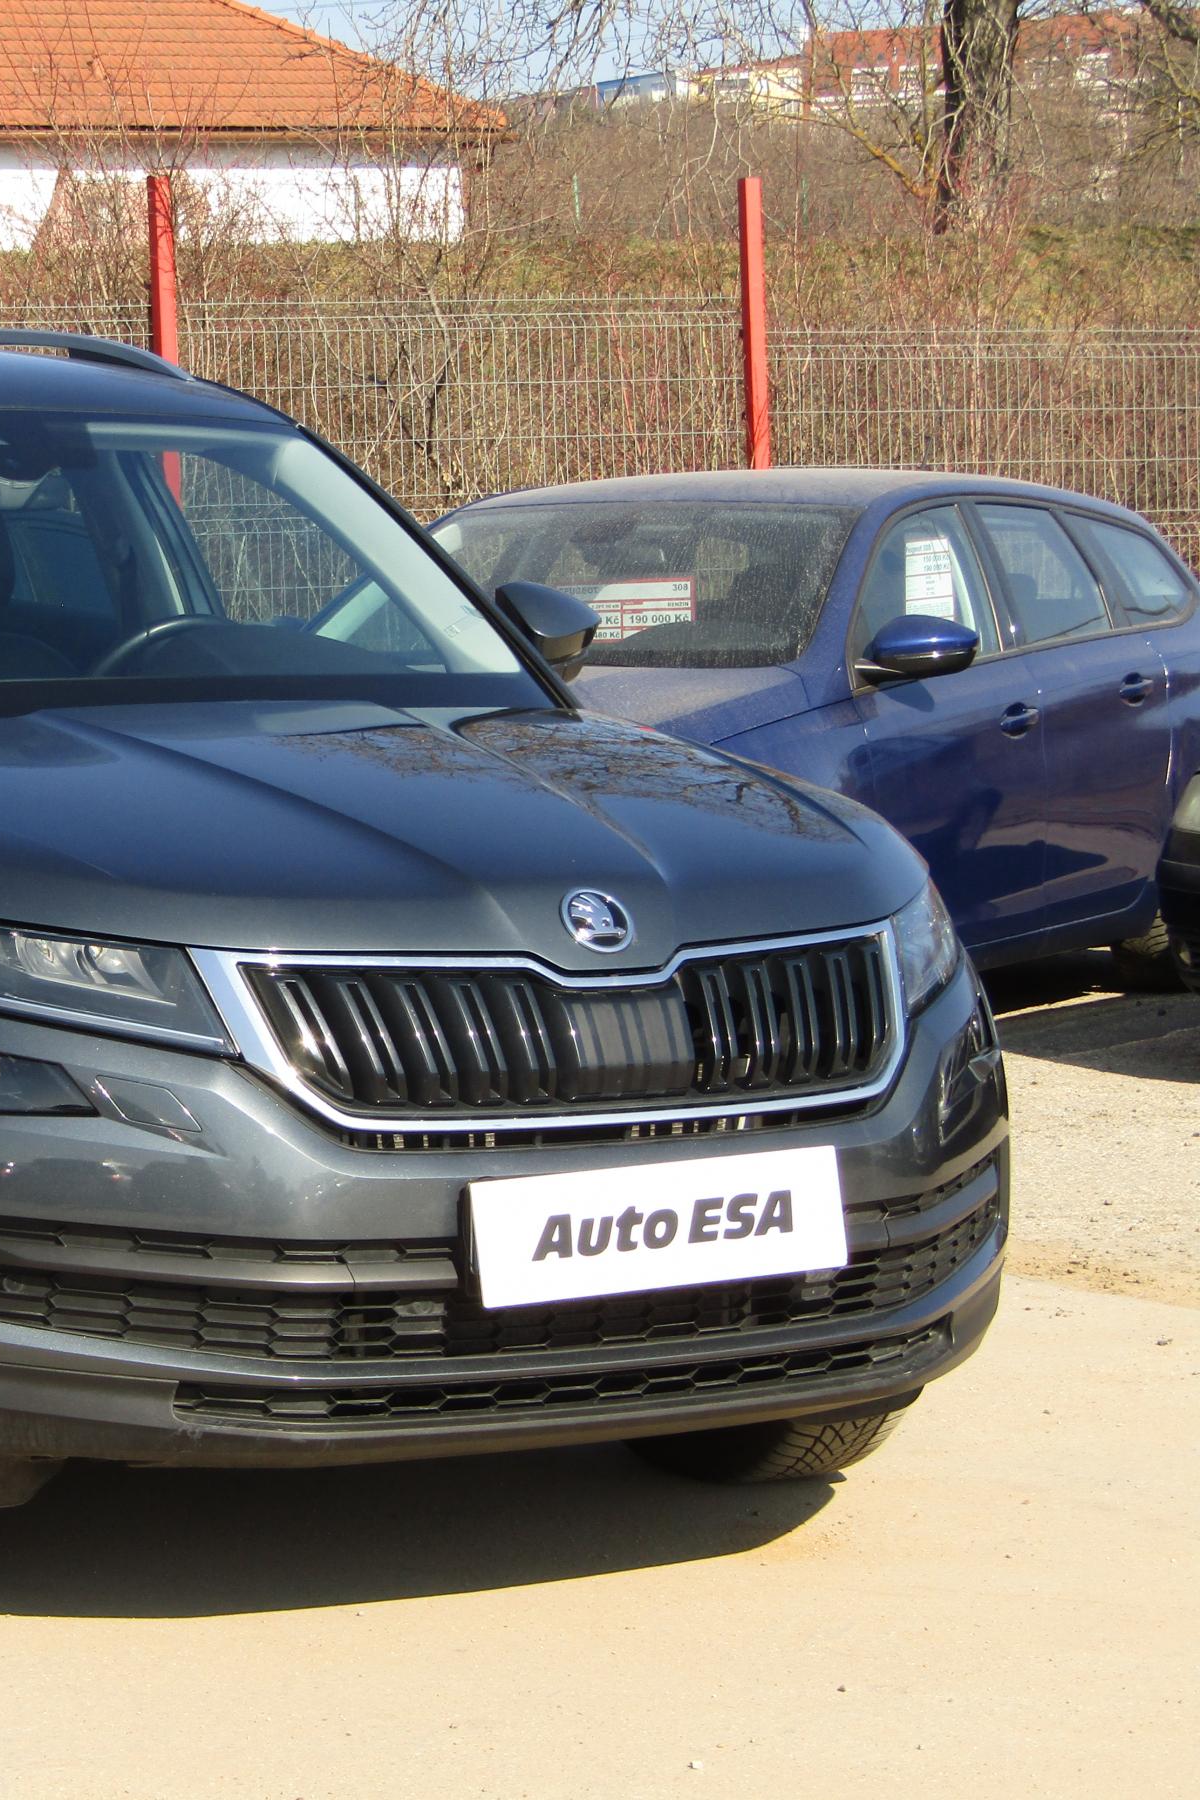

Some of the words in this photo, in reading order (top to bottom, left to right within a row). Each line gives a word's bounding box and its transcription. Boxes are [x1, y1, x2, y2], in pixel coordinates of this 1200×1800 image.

[672, 583, 689, 591] 308
[605, 615, 620, 625] Kč
[629, 614, 648, 624] 190
[651, 614, 671, 624] 000
[674, 613, 689, 623] Kč
[531, 1206, 679, 1262] Auto
[687, 1189, 794, 1244] ESA
